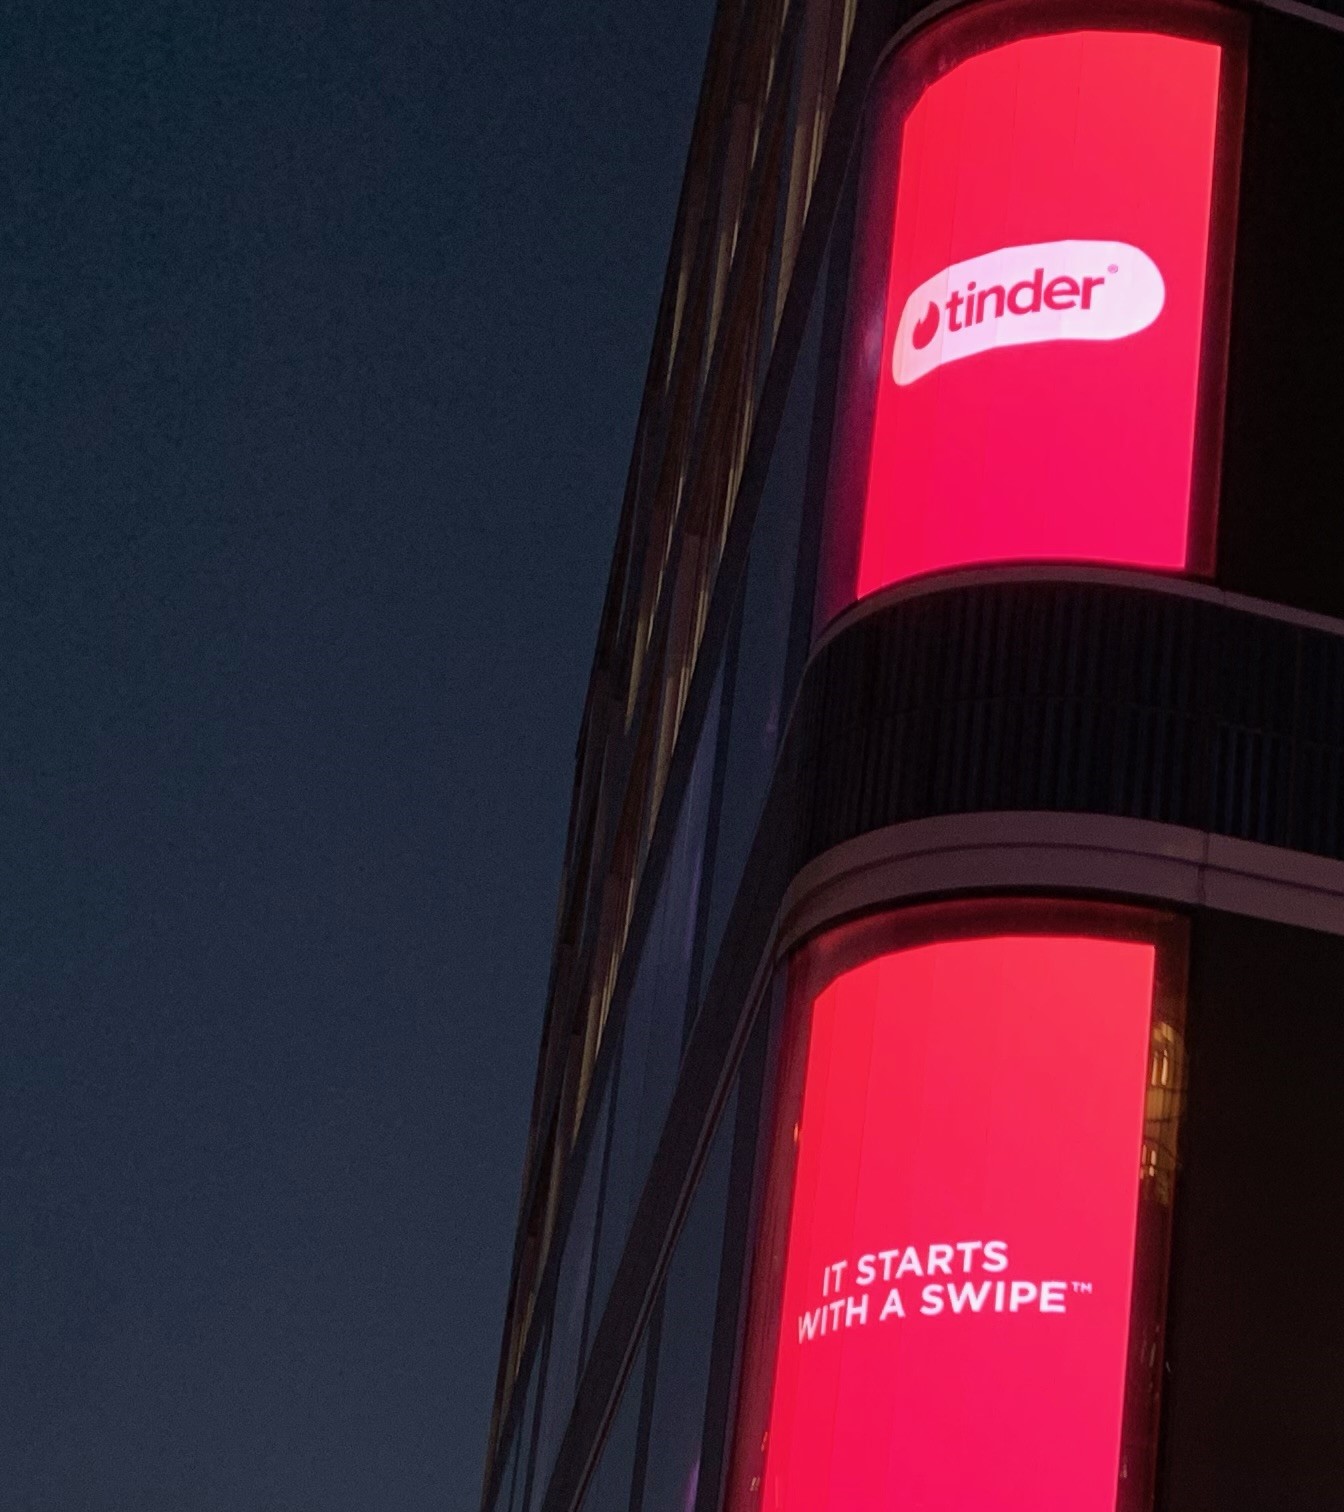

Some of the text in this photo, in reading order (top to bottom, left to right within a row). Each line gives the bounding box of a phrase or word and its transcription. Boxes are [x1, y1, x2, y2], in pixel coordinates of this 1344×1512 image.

[822, 1240, 1009, 1297] IT STARTS
[798, 1293, 869, 1345] WITH
[879, 1287, 906, 1321] A
